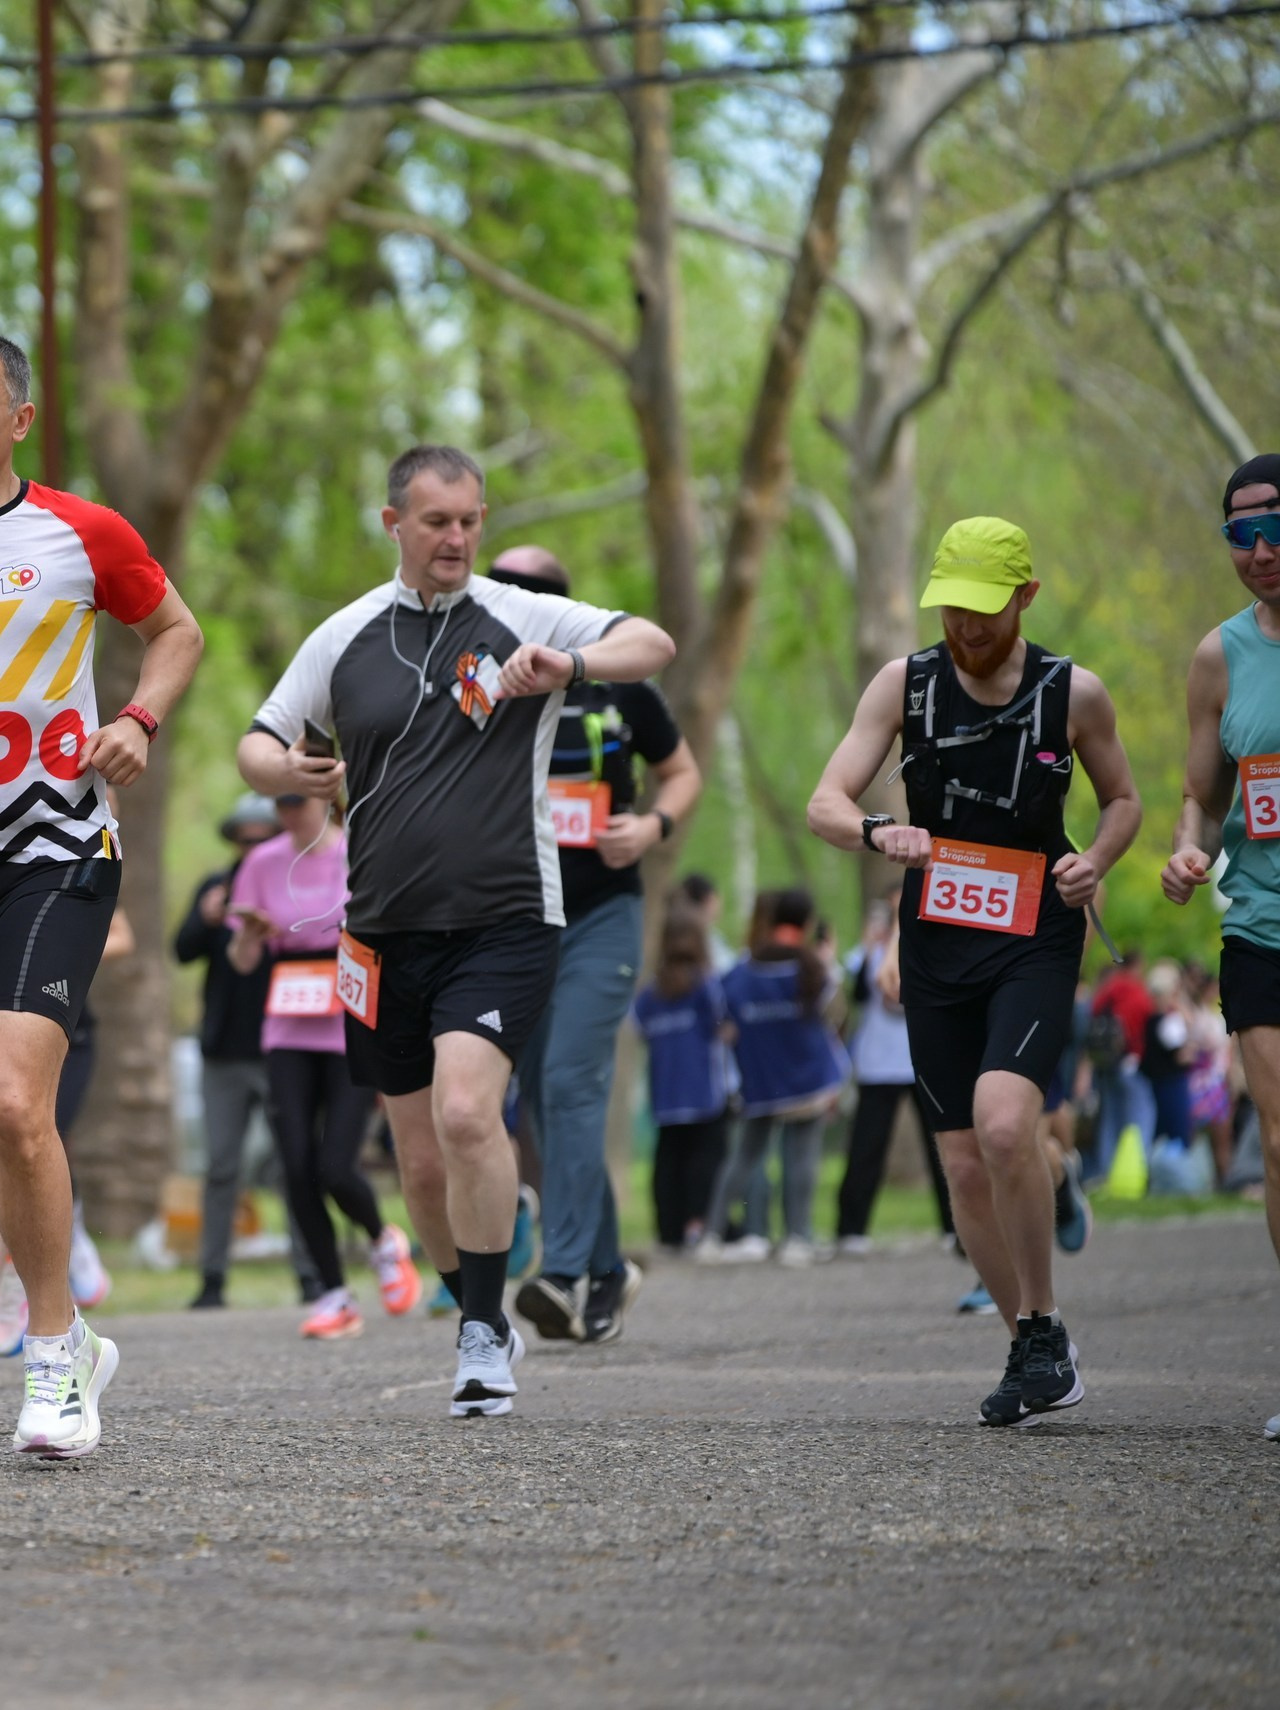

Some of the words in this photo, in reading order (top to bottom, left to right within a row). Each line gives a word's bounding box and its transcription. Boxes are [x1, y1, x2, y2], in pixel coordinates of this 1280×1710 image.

[1254, 795, 1280, 826] 3
[933, 879, 1009, 918] 355
[41, 985, 70, 1007] adidas
[339, 963, 364, 1006] 367
